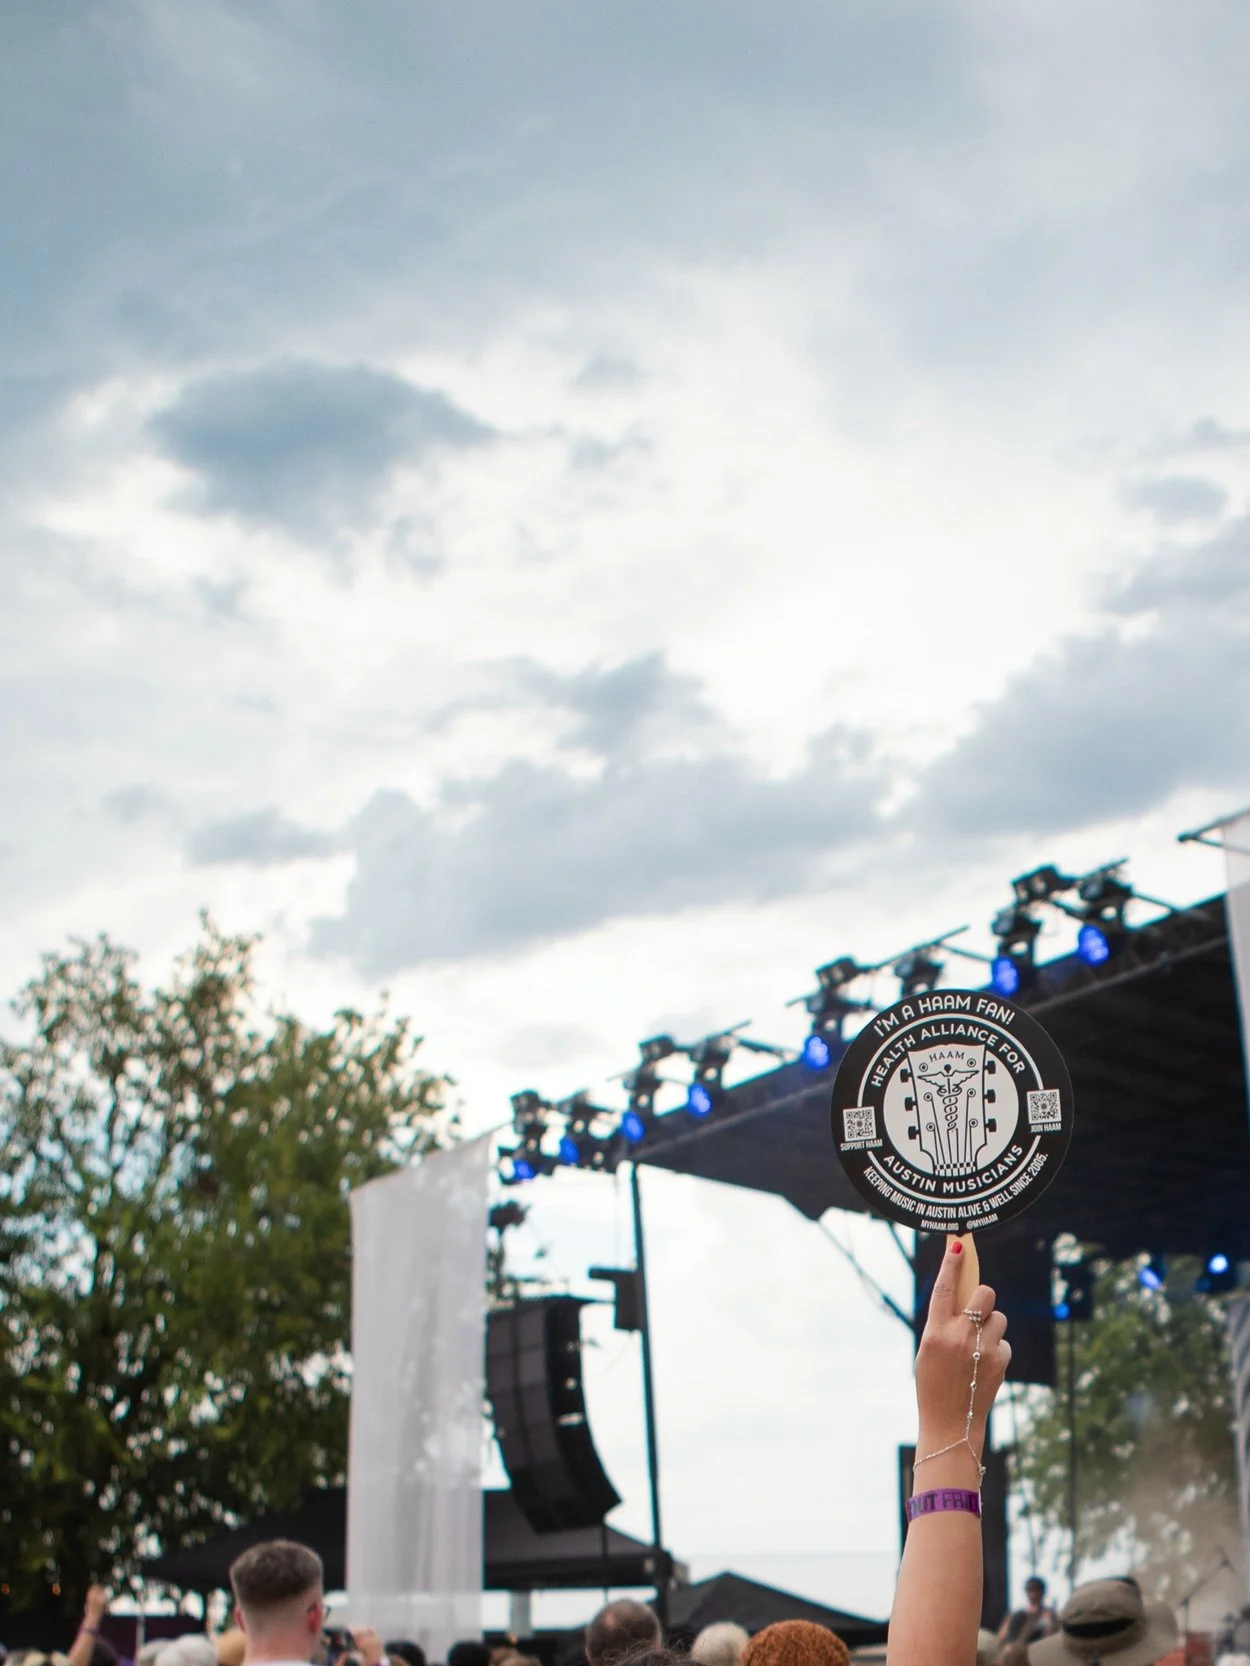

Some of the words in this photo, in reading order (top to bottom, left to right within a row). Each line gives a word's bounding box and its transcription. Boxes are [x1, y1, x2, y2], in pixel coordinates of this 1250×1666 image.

[873, 1012, 899, 1037] I'M
[901, 1006, 915, 1020] A
[918, 995, 971, 1014] HAAM
[976, 998, 1015, 1025] FAN!
[871, 1034, 916, 1087] HEALTH
[921, 1024, 998, 1047] ALLIANCE
[999, 1043, 1026, 1074] FOR
[929, 1050, 965, 1063] HAAM
[1030, 1123, 1043, 1132] JOIN
[1044, 1122, 1061, 1132] HAAM
[840, 1140, 865, 1151] SUPPORT
[866, 1139, 883, 1148] HAAM
[884, 1155, 936, 1192] AUSTIN
[943, 1145, 1023, 1193] MUSICIANS
[863, 1166, 893, 1198] KEEPING
[890, 1189, 915, 1212] MUSIC
[915, 1204, 925, 1216] IN
[926, 1206, 957, 1219] AUSTIN
[958, 1202, 983, 1218] ALIVE
[983, 1201, 991, 1212] &
[988, 1186, 1013, 1208] WELL
[1011, 1171, 1033, 1196] SINCE
[1029, 1153, 1049, 1177] 2005.
[920, 1219, 959, 1231] MYHAAM.ORG
[966, 1212, 999, 1230] @MYHAAM
